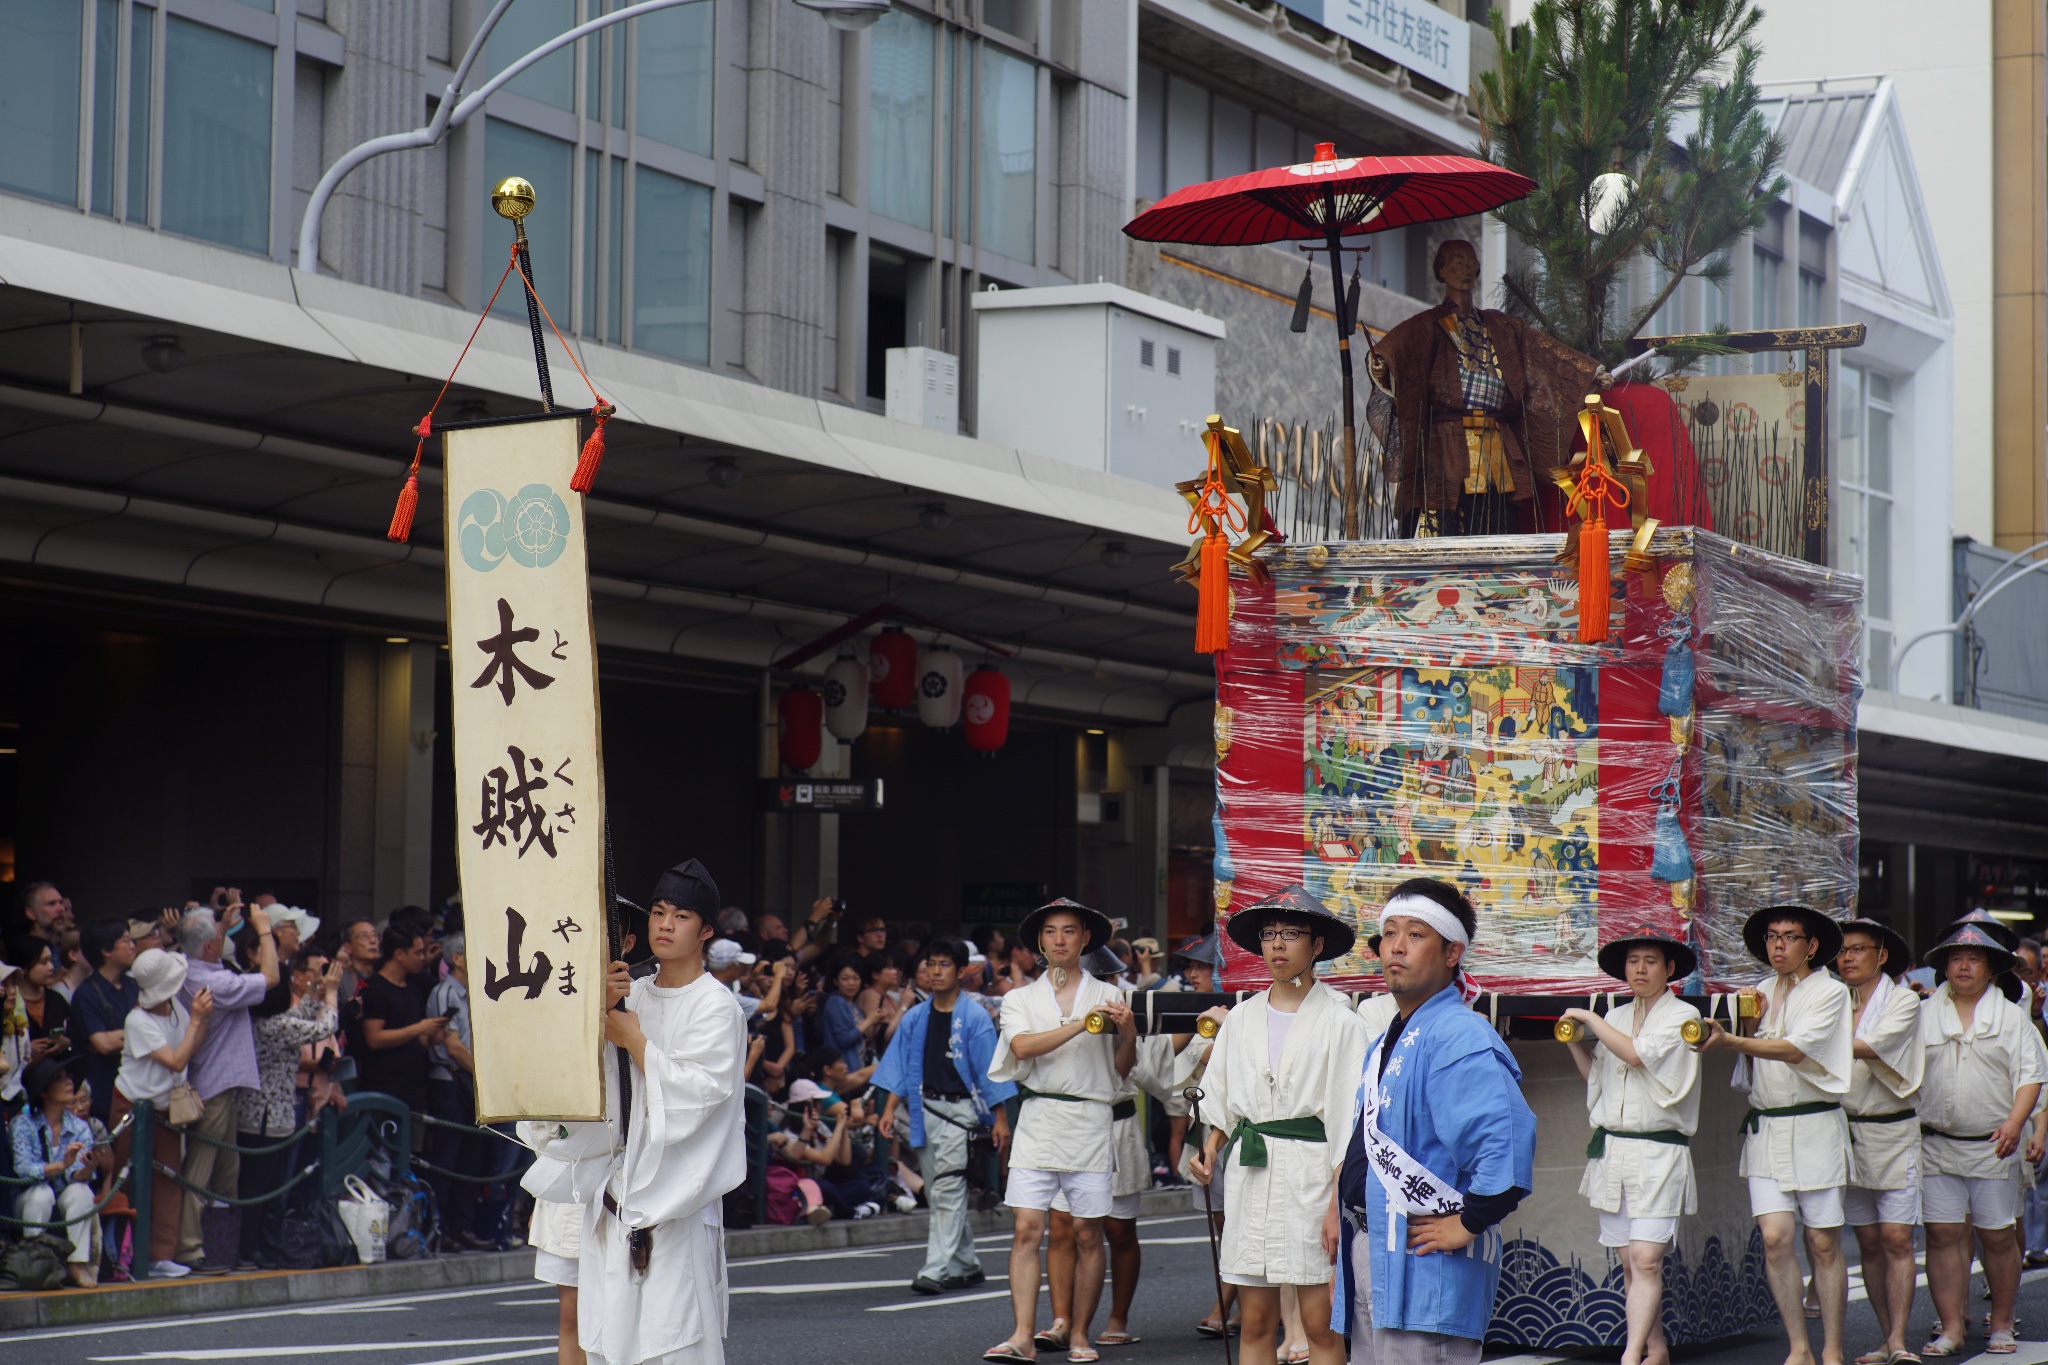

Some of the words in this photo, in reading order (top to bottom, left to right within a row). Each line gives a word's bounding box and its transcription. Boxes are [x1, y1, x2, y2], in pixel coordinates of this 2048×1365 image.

[1346, 0, 1449, 69] 三井住友銀行
[470, 598, 557, 1001] 木賊山
